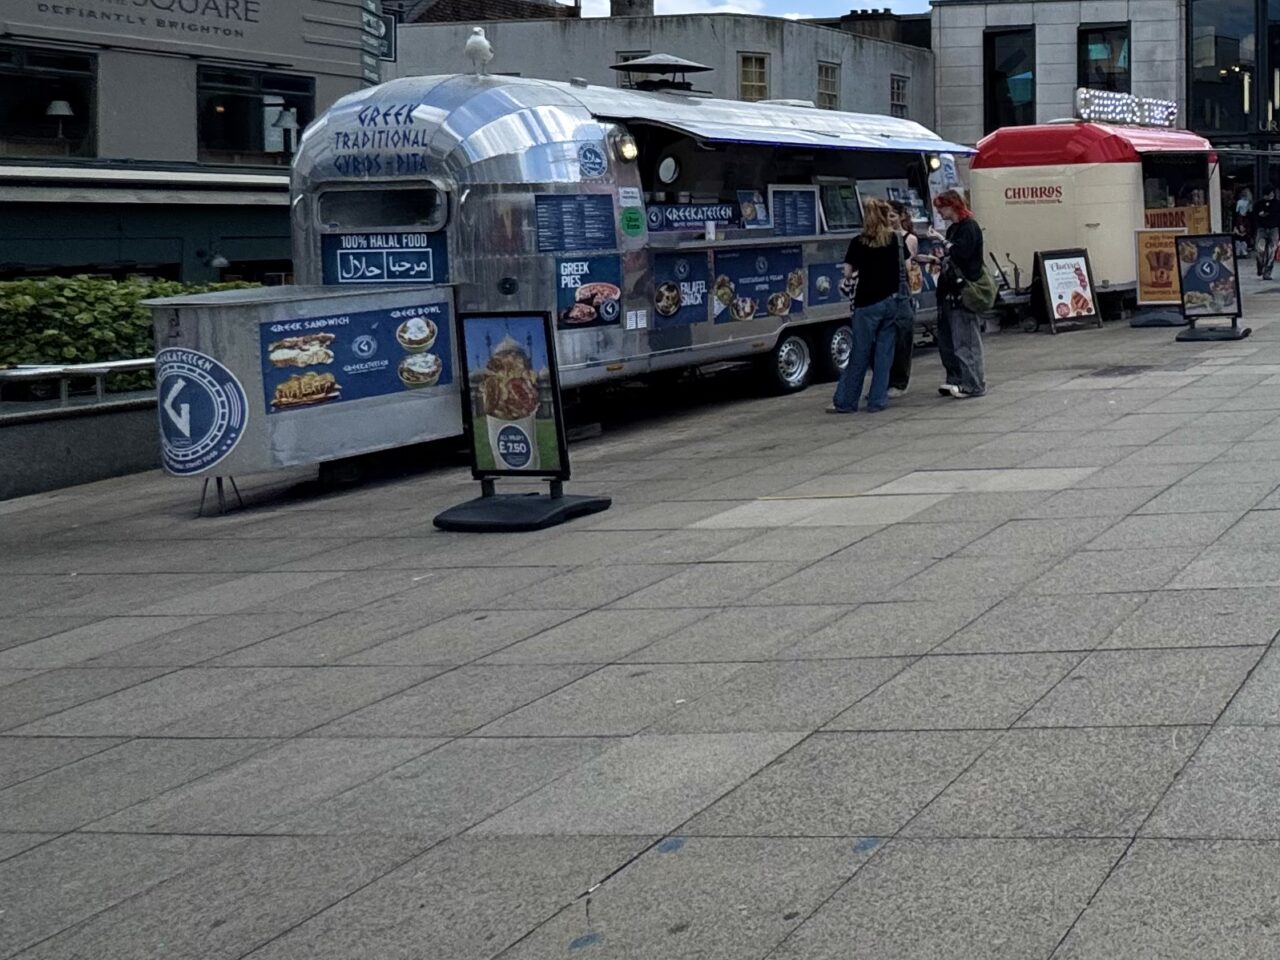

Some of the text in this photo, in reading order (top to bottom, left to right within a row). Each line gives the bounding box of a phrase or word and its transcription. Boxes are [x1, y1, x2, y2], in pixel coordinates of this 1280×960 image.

[37, 3, 244, 38] DEFIANTLY BRIGHTON
[358, 103, 420, 127] GREEK
[334, 129, 427, 149] TRADITIONAL
[334, 154, 382, 174] GYROS
[396, 152, 428, 172] PITA
[1004, 186, 1063, 200] CHURROS
[340, 233, 428, 248] 100% HALAL FOOD
[342, 255, 382, 278] حلال
[388, 256, 428, 276] مرحبا
[560, 261, 590, 276] GREEK
[560, 275, 582, 288] PIES
[417, 306, 441, 315] BOWL
[270, 317, 350, 333] GREEK SANDWICH
